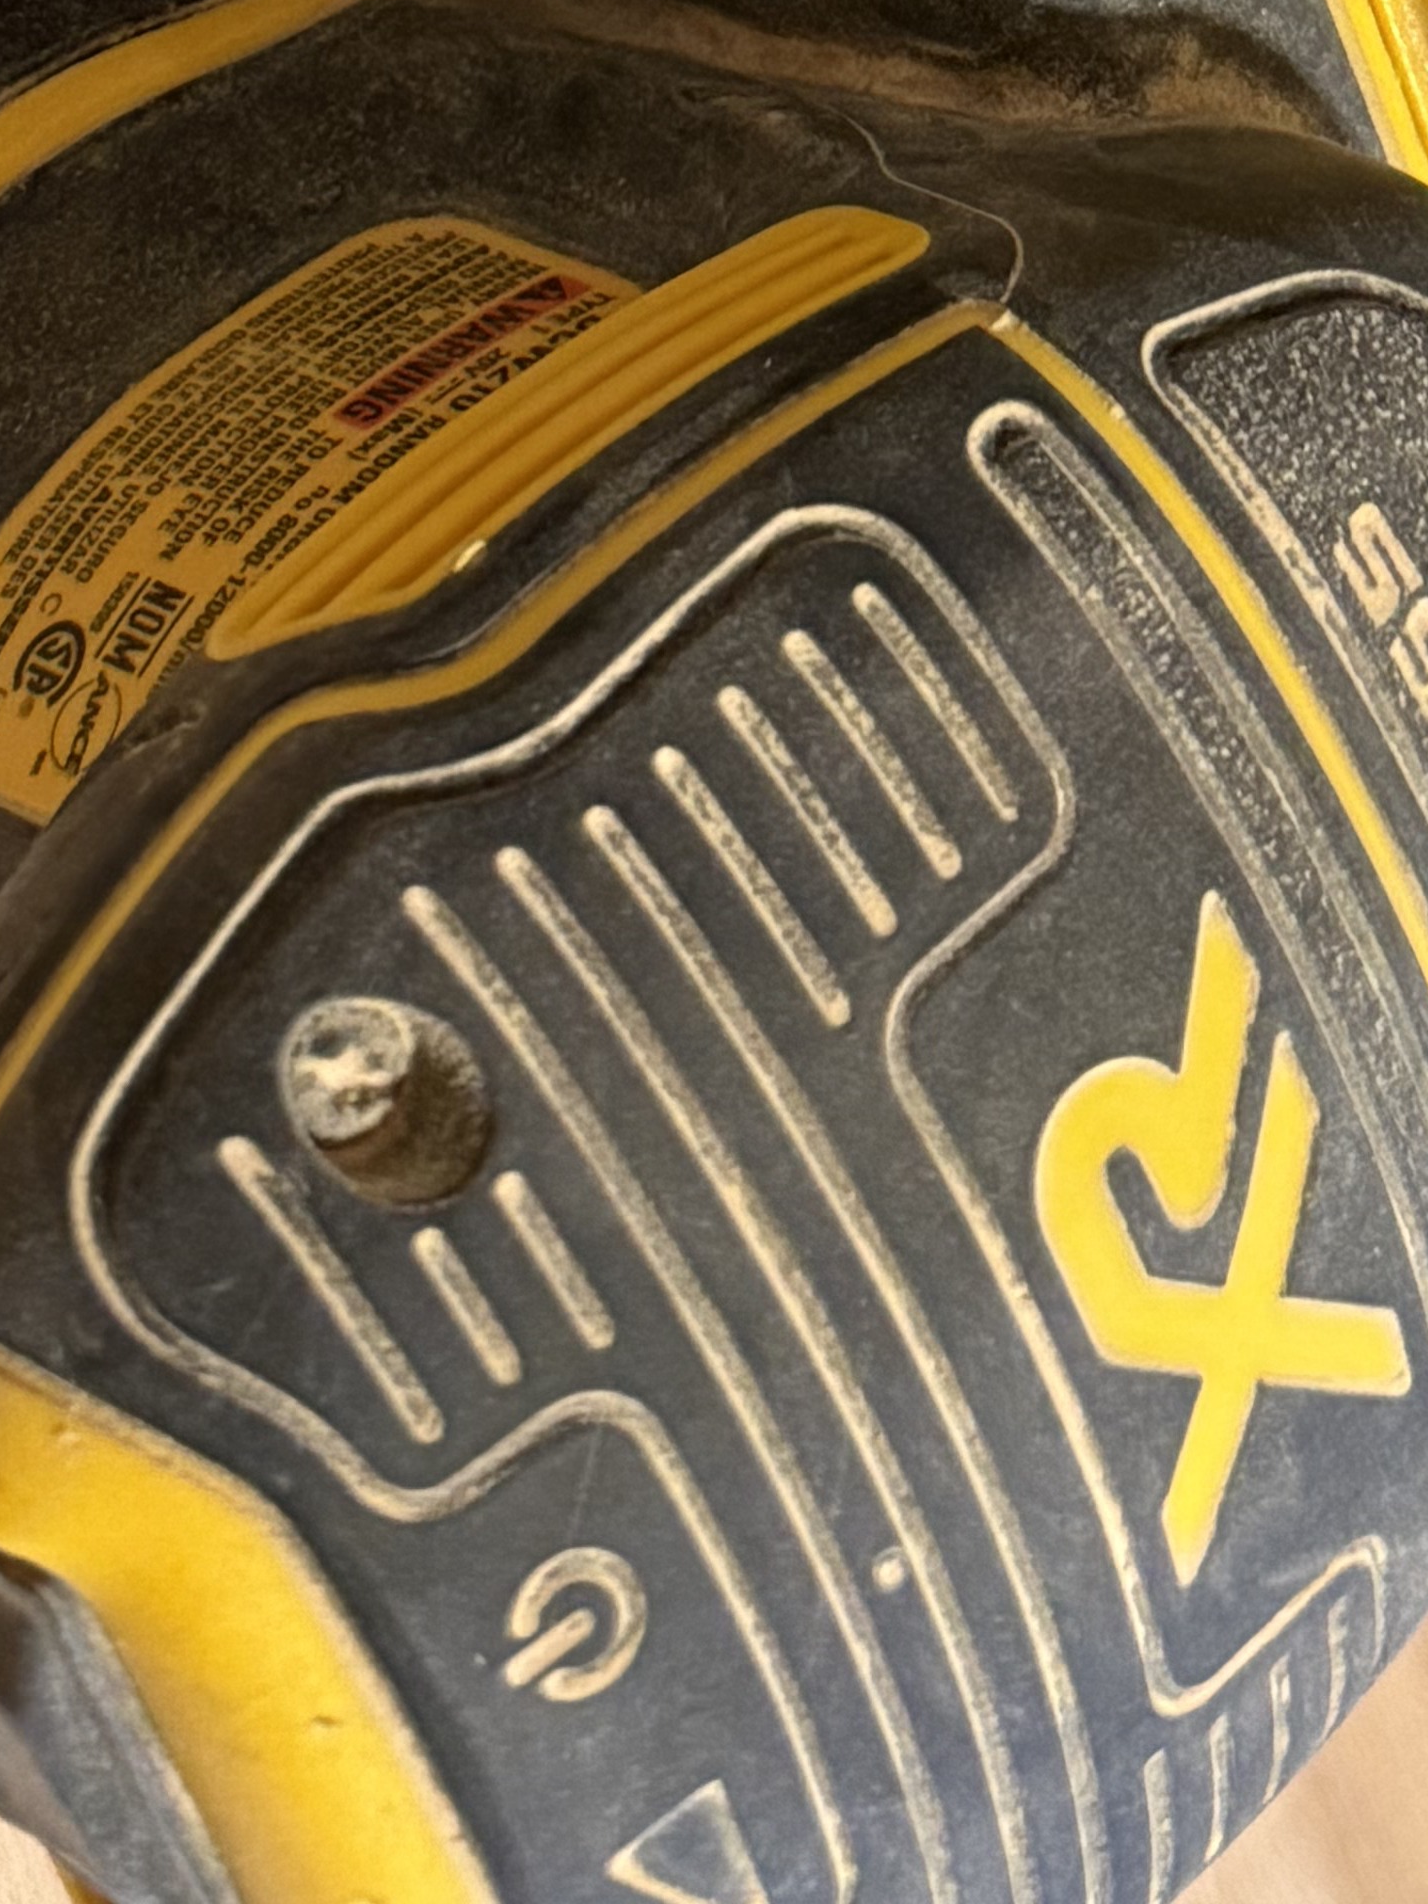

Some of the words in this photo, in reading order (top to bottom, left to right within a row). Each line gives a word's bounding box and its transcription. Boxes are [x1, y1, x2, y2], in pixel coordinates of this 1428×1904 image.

[339, 304, 535, 428] WARNING
[287, 386, 347, 431] READ
[198, 415, 287, 491] PROPER
[275, 427, 326, 467] THE
[306, 436, 343, 464] TO
[156, 433, 290, 561] INSTRUCTION
[156, 492, 203, 535] EYE
[221, 463, 310, 545] REDUCE
[224, 466, 282, 514] RISK
[200, 515, 231, 548] OF
[100, 578, 187, 676] NOM
[62, 670, 107, 776] ANCE
[1034, 888, 1411, 1589] XR
